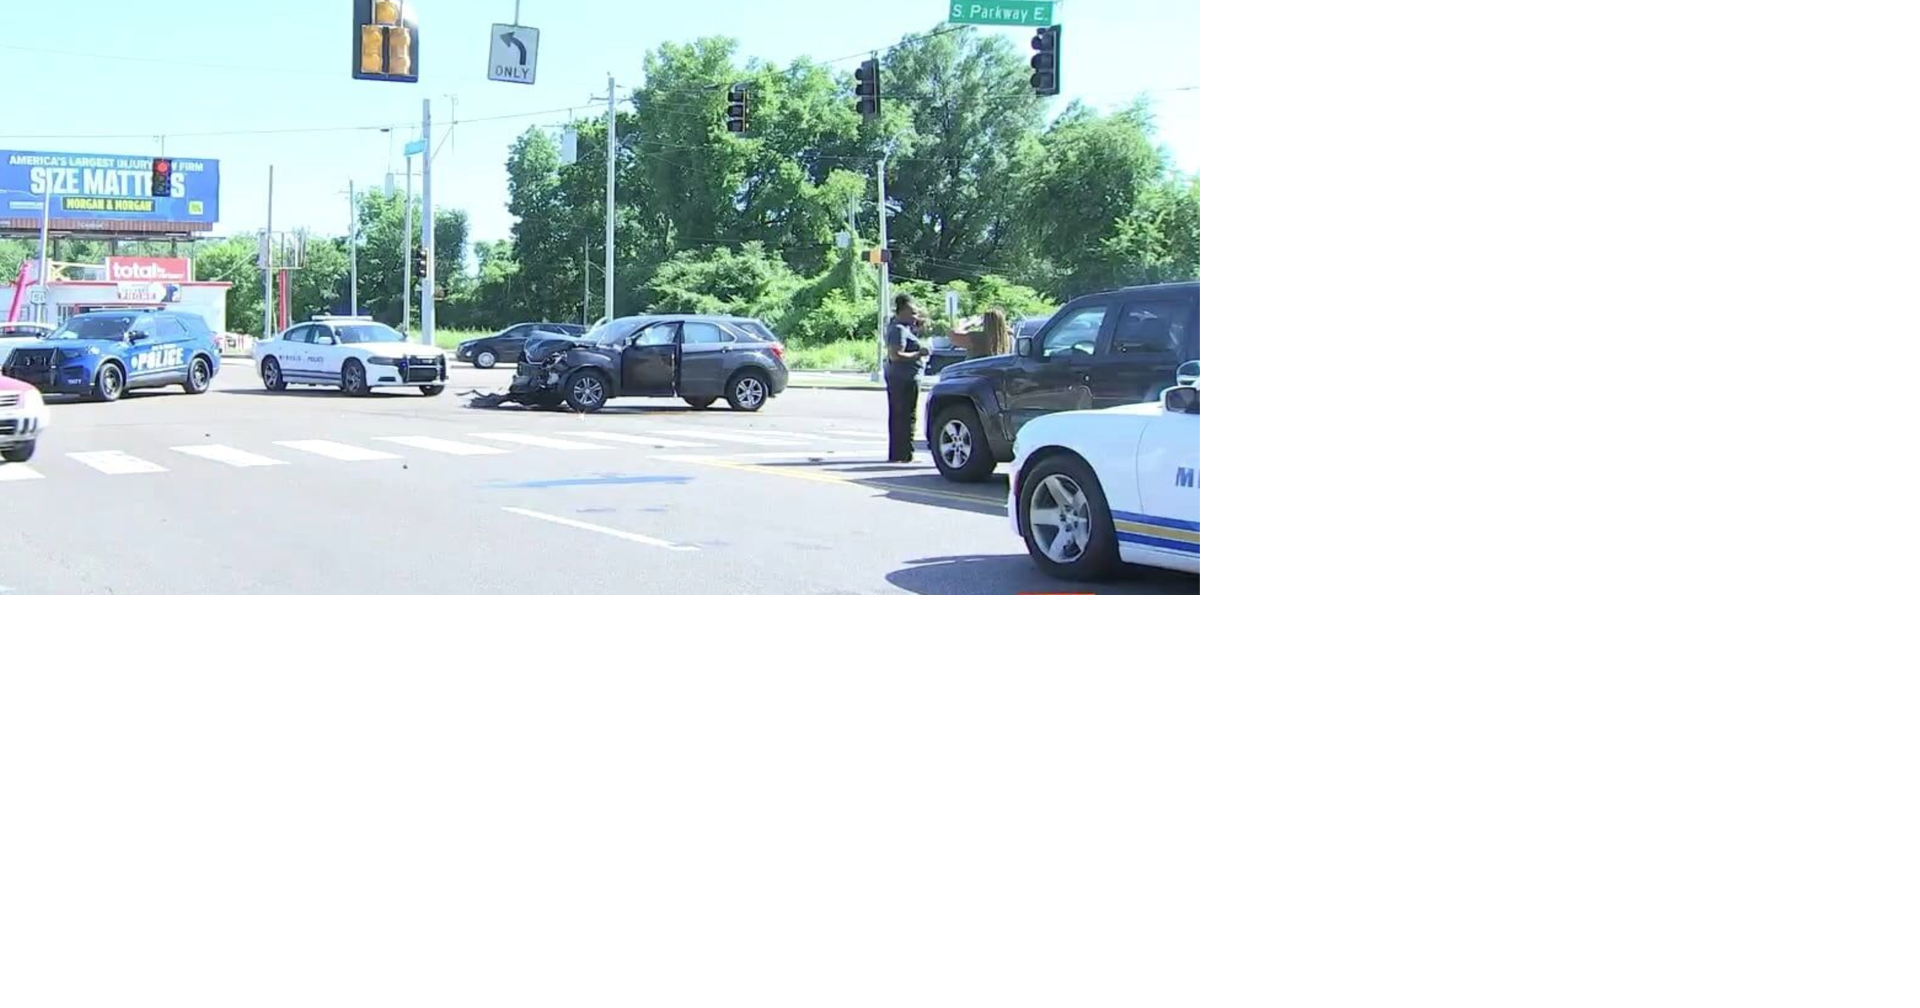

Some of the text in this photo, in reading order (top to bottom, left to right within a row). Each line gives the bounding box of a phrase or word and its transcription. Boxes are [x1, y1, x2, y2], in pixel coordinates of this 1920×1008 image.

[952, 4, 1048, 23] S. Parkway E.
[495, 65, 530, 79] ONLY
[10, 155, 67, 166] AMERICA'S
[69, 157, 114, 168] LARGEST
[30, 167, 79, 194] SIZE
[66, 198, 152, 211] MORGAN & MORGAN
[112, 262, 157, 278] total
[137, 347, 184, 371] POLICE
[1176, 467, 1200, 488] M
